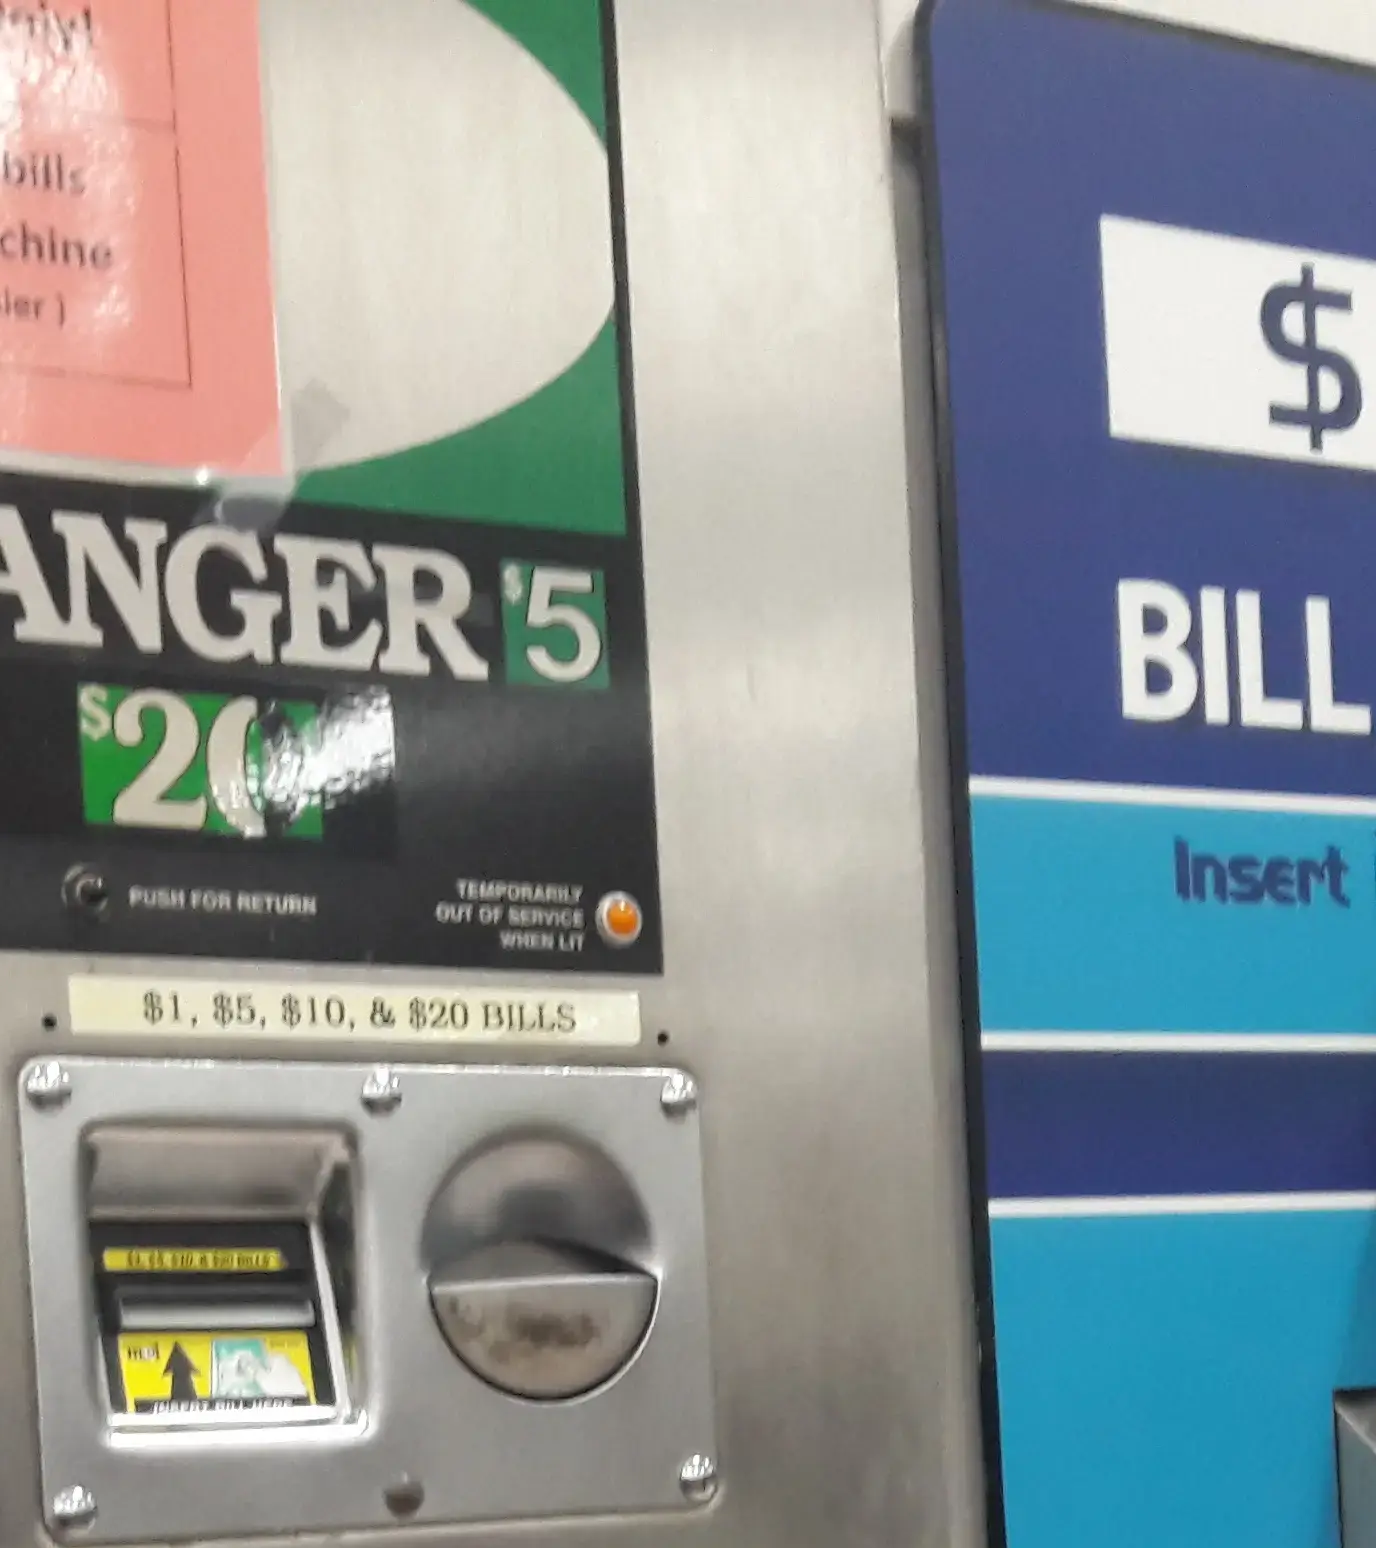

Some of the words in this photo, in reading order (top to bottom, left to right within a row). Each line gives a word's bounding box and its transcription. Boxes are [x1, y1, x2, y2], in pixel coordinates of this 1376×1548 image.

[2, 150, 87, 196] bills
[502, 566, 603, 683] $5
[1118, 577, 1373, 738] BILL
[456, 878, 584, 903] TEMPORARILY
[1172, 835, 1352, 909] Insert
[128, 885, 186, 910] PUSH
[190, 888, 232, 913] FOR
[236, 890, 318, 916] RETURN
[435, 901, 473, 924] OUT
[478, 903, 503, 925] OF
[507, 904, 585, 929] SERVICE
[499, 929, 554, 950] WHEN
[559, 931, 585, 951] LIT
[142, 989, 198, 1028] $1,
[211, 991, 267, 1031] $5,
[280, 993, 356, 1033] $10,
[369, 997, 396, 1028] &
[408, 996, 469, 1033] $20
[482, 1002, 577, 1033] BILLS
